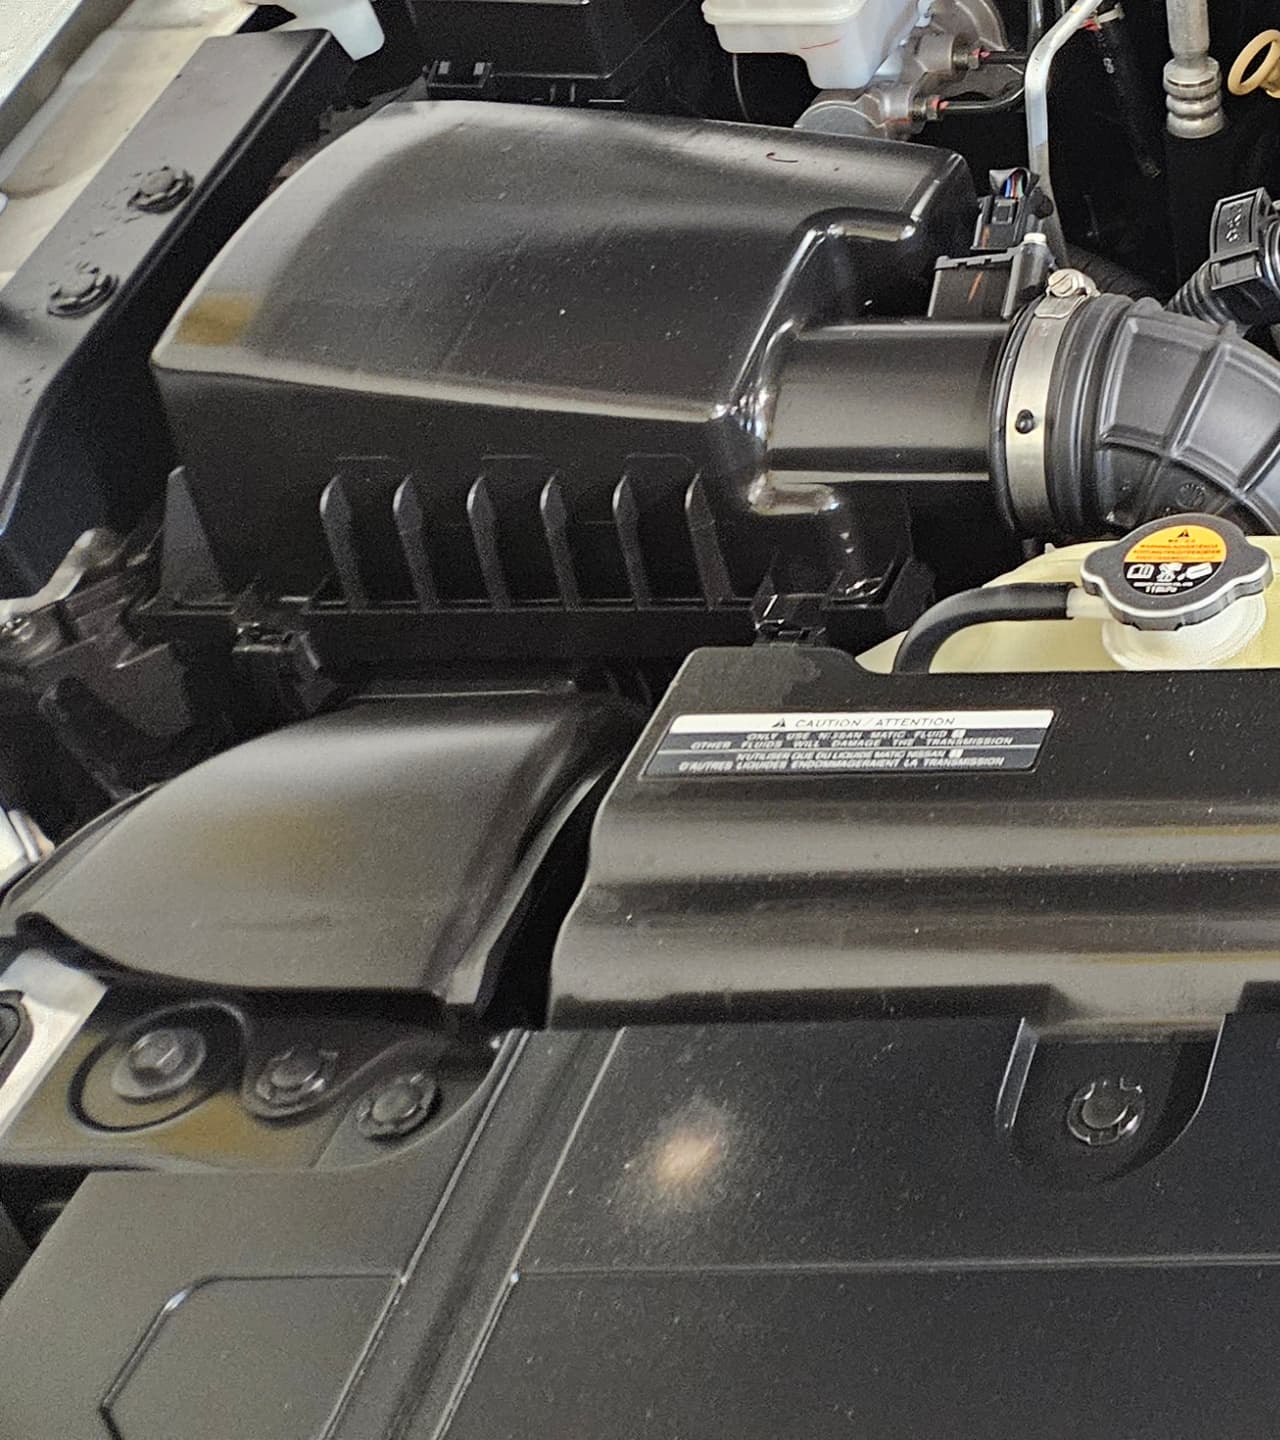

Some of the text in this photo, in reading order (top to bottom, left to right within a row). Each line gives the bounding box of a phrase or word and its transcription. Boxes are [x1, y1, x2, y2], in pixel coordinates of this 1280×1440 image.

[795, 719, 862, 727] CAUTION
[875, 717, 955, 726] ATTENTION
[786, 732, 809, 740] USE
[818, 731, 863, 739] NISSAN
[870, 730, 906, 738] MATIC
[914, 729, 948, 737] FLUID
[690, 741, 732, 749] OTHER
[741, 740, 783, 748] FLUIDS
[831, 738, 881, 746] DAMAGE
[893, 738, 915, 746] THE
[926, 736, 1013, 745] TRANSMISSION
[907, 748, 946, 757] NISSAN
[903, 758, 917, 766] LA
[922, 757, 1004, 766] TRANSMISSION
